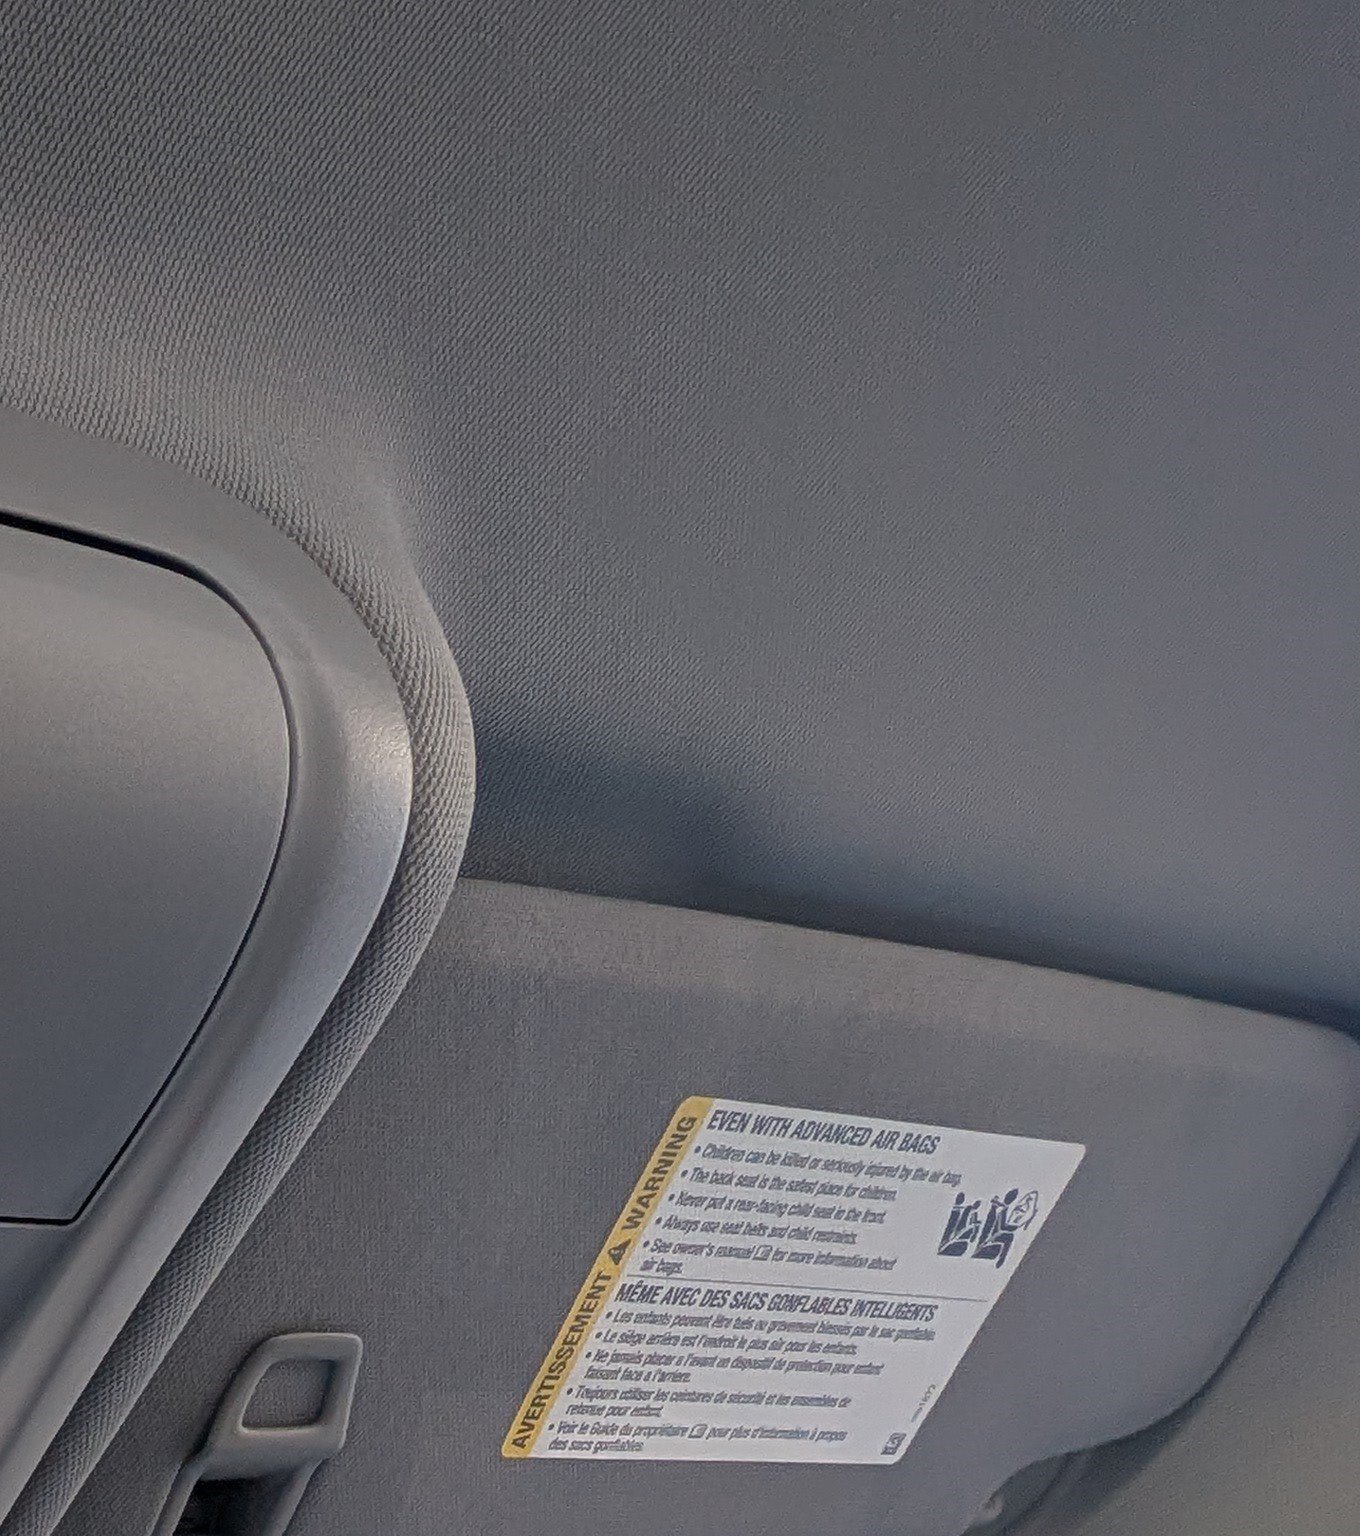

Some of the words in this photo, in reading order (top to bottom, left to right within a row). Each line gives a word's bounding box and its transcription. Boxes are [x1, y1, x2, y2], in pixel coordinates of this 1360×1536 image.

[706, 1109, 753, 1133] EVEN
[750, 1115, 794, 1138] WITH
[789, 1119, 873, 1147] ADVANCED
[870, 1129, 900, 1150] AIR
[897, 1132, 941, 1155] BAGS
[622, 1116, 697, 1231] WARNING
[688, 1167, 710, 1184] The
[662, 1214, 701, 1235] Always
[614, 1280, 664, 1304] MÊME
[660, 1286, 702, 1306] AVEC
[699, 1289, 732, 1308] DES
[729, 1290, 769, 1311] SACS
[766, 1293, 852, 1316] GONFLABLES
[850, 1299, 939, 1322] INTELLIGENTS
[511, 1272, 613, 1449] AVERTISSEMENT
